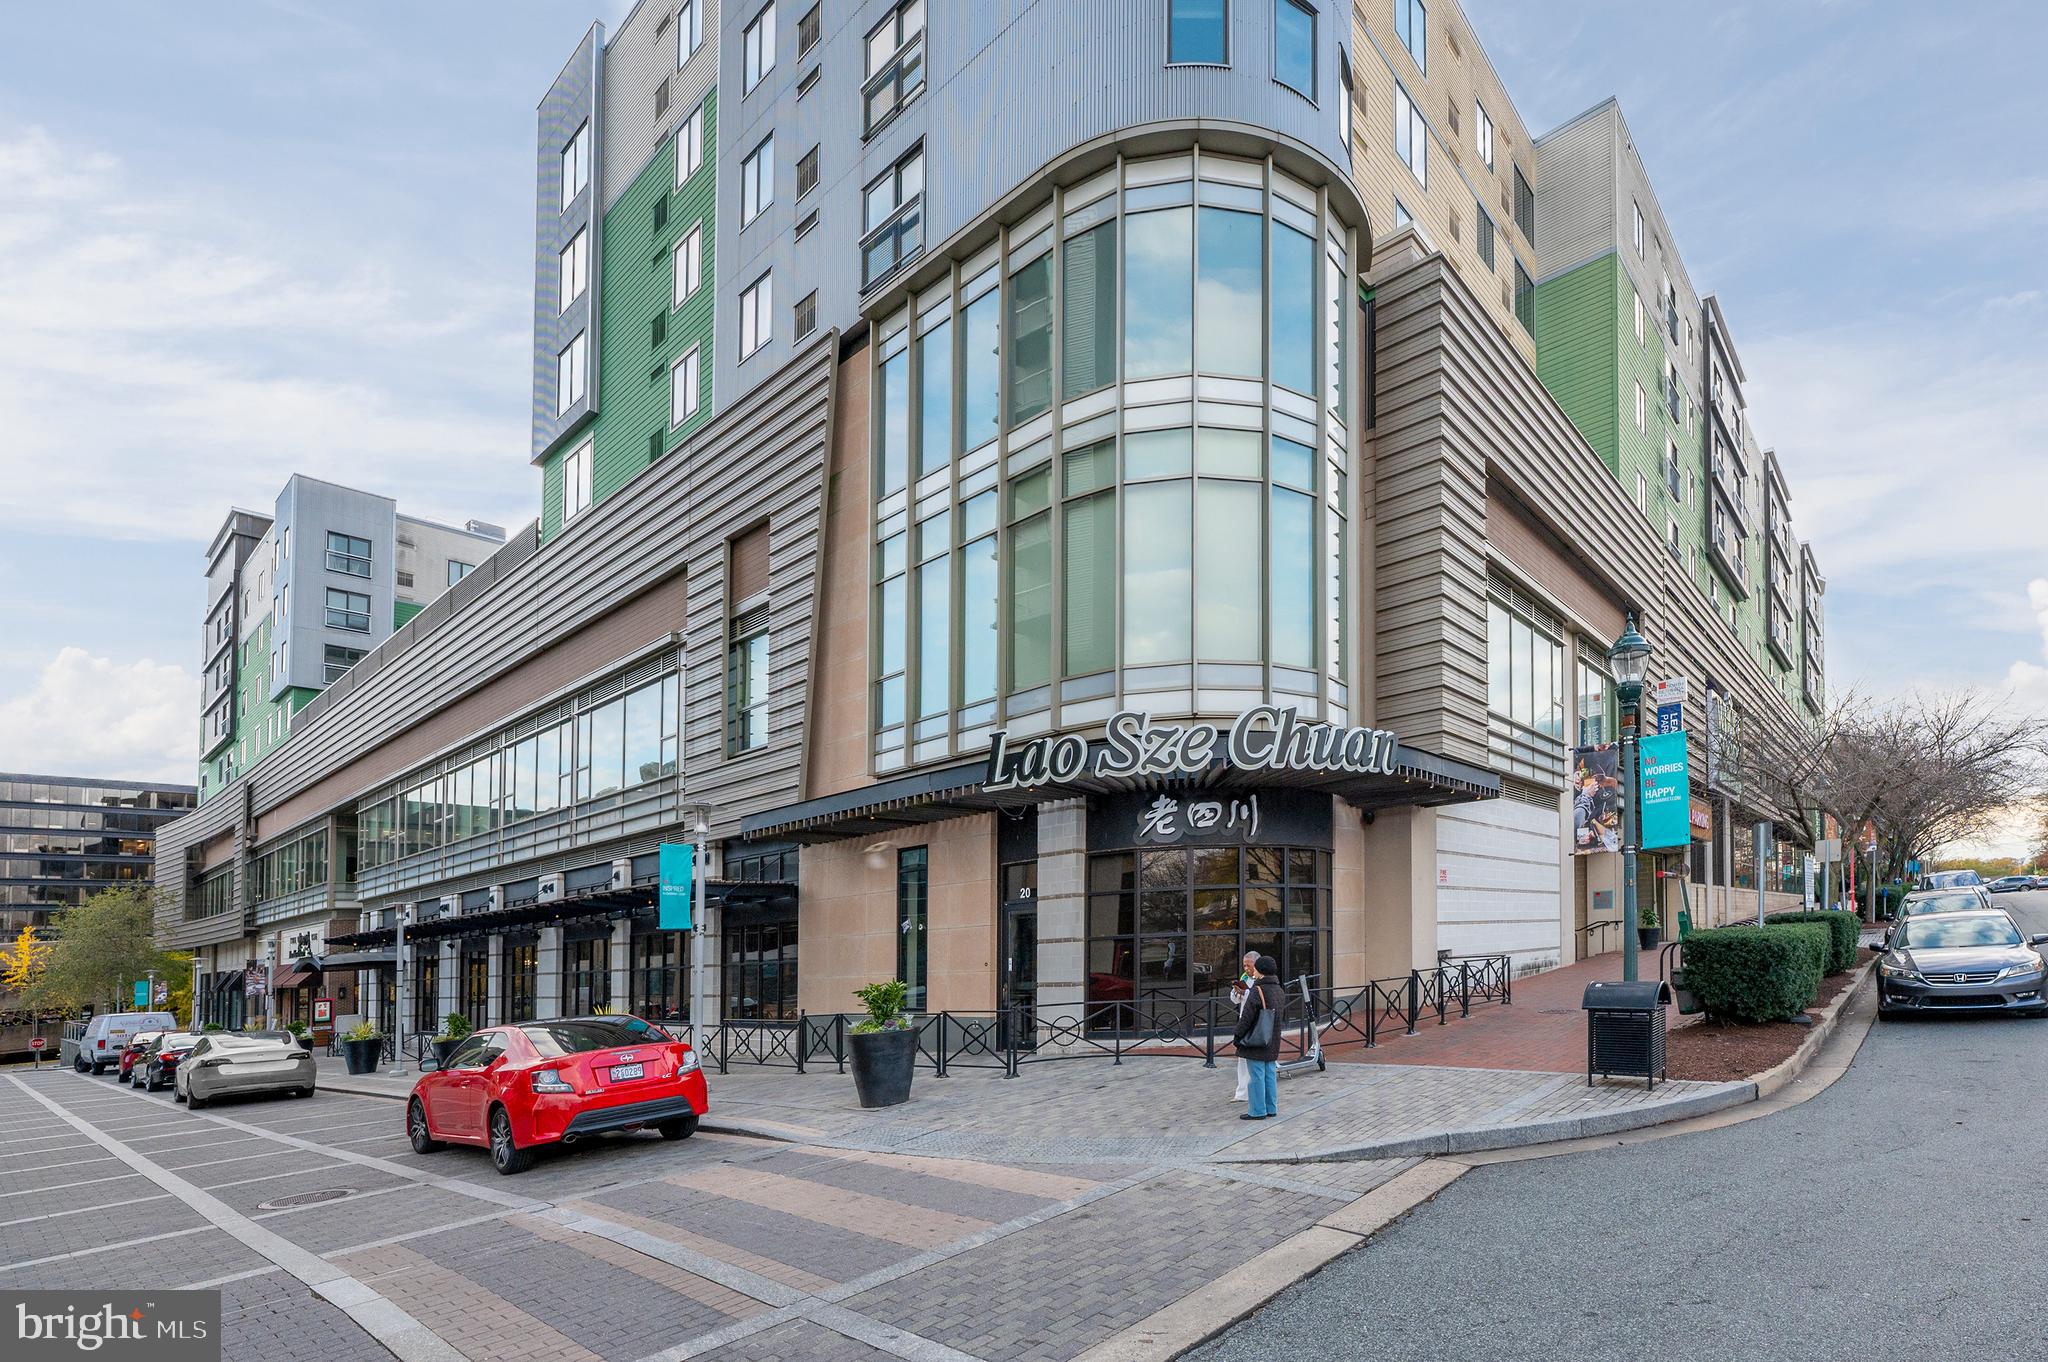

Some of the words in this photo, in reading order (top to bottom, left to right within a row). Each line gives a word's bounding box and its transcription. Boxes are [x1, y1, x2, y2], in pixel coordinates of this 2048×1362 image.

[982, 729, 1089, 793] Lao
[1096, 709, 1219, 779] Sze
[1228, 704, 1400, 776] Chuan
[1644, 756, 1656, 766] NO
[1644, 762, 1684, 776] WORRIES
[1645, 778, 1657, 788] BE
[1645, 786, 1676, 799] HAPPY
[1139, 794, 1259, 837] 老四川
[1020, 887, 1031, 899] 20
